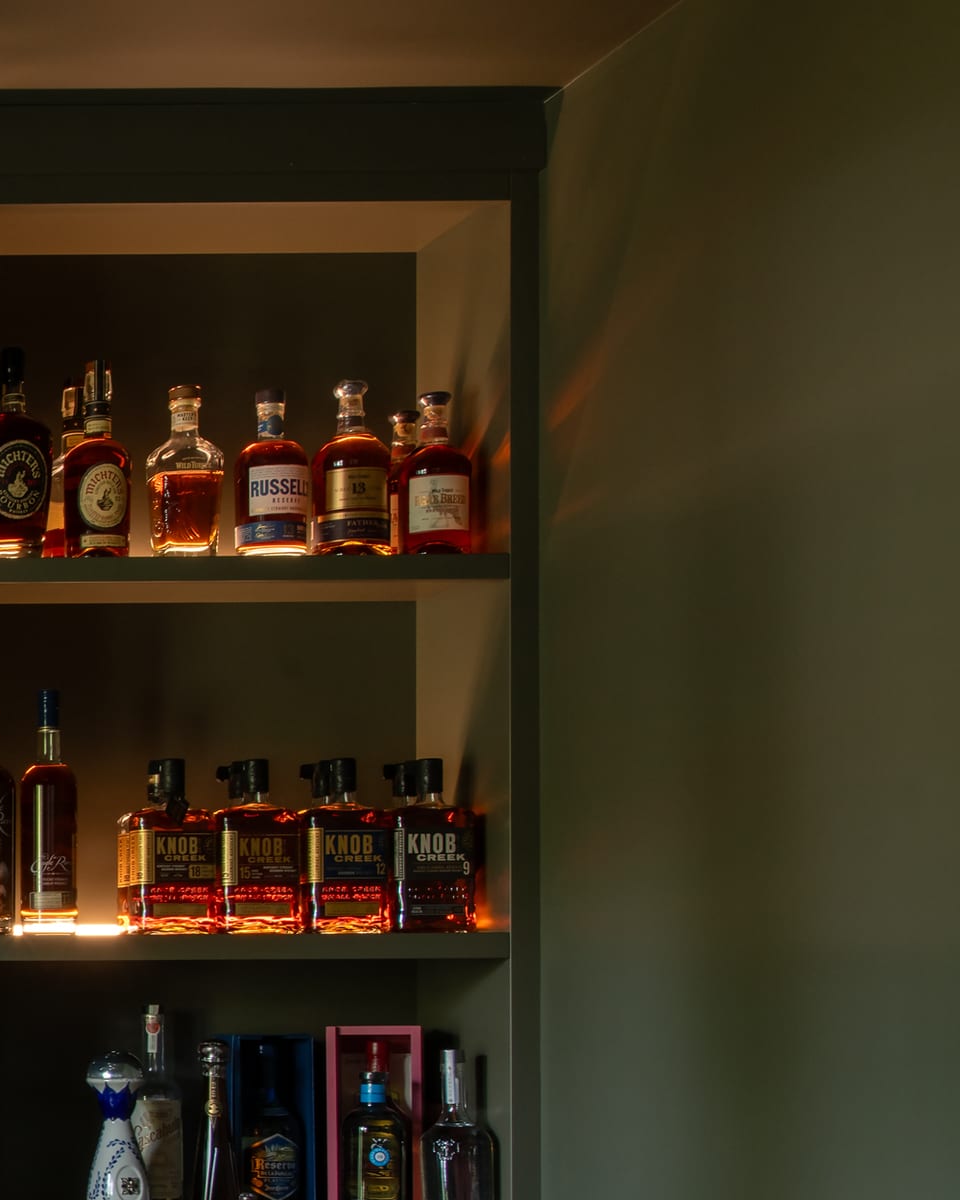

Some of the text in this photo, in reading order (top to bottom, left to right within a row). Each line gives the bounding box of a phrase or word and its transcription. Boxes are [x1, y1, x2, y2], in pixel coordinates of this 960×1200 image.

[352, 482, 367, 495] 13
[156, 836, 199, 856] KNOB
[239, 837, 283, 857] KNOB
[324, 833, 374, 856] KNOB
[407, 832, 457, 855] KNOB
[163, 854, 208, 862] CREEK
[247, 856, 293, 864] CREEK
[333, 854, 383, 863] CREEK
[415, 853, 466, 862] CREEK
[190, 865, 202, 877] 18
[375, 862, 387, 876] 12
[462, 860, 471, 876] 9
